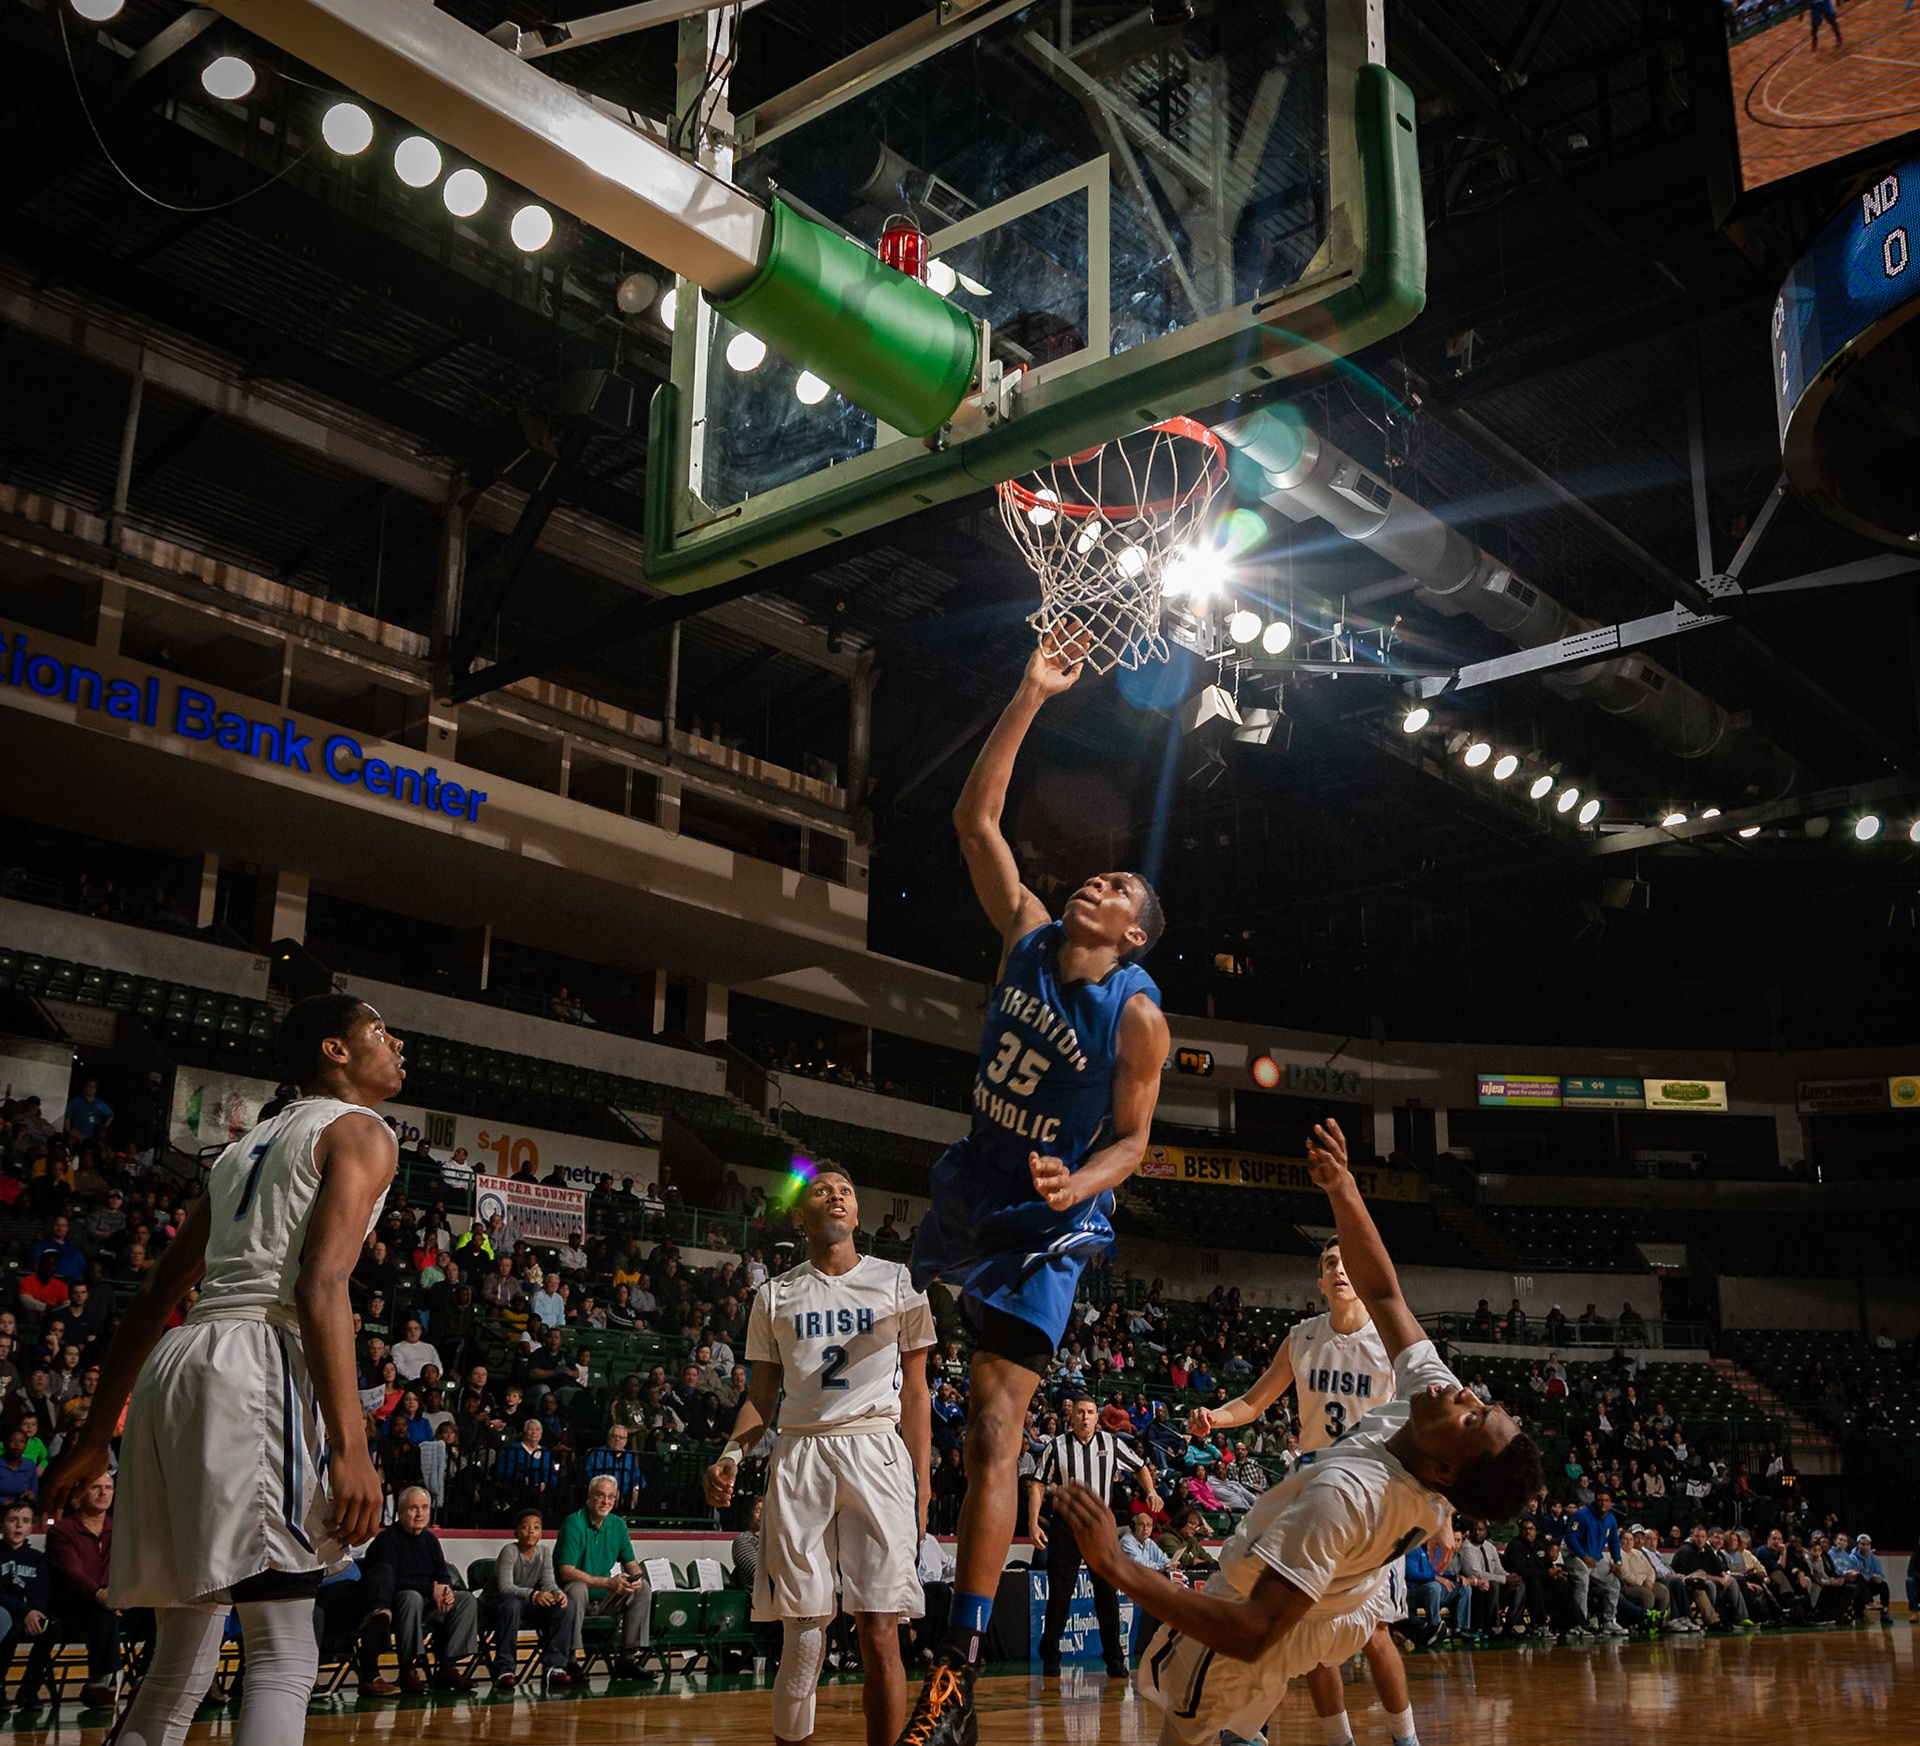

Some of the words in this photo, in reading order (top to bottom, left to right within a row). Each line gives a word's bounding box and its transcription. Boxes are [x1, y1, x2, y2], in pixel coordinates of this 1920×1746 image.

[1862, 175, 1899, 225] ND
[175, 685, 314, 772] Bank
[323, 734, 488, 823] Center
[986, 1030, 1052, 1097] 35
[1285, 1063, 1362, 1096] PSEG
[1481, 1081, 1505, 1096] njea
[401, 1121, 420, 1142] to
[428, 1114, 454, 1148] 106
[477, 1130, 539, 1178] $10
[479, 1177, 532, 1197] MERCER
[534, 1187, 583, 1204] COUNTY
[1184, 1155, 1232, 1179] BEST
[1239, 1158, 1377, 1195] SUPERMET
[891, 1198, 909, 1224] 107
[1513, 1276, 1534, 1297] 109
[795, 1307, 875, 1341] IRISH
[821, 1344, 850, 1391] 2
[1309, 1368, 1372, 1398] IRISH
[1324, 1401, 1347, 1439] 3
